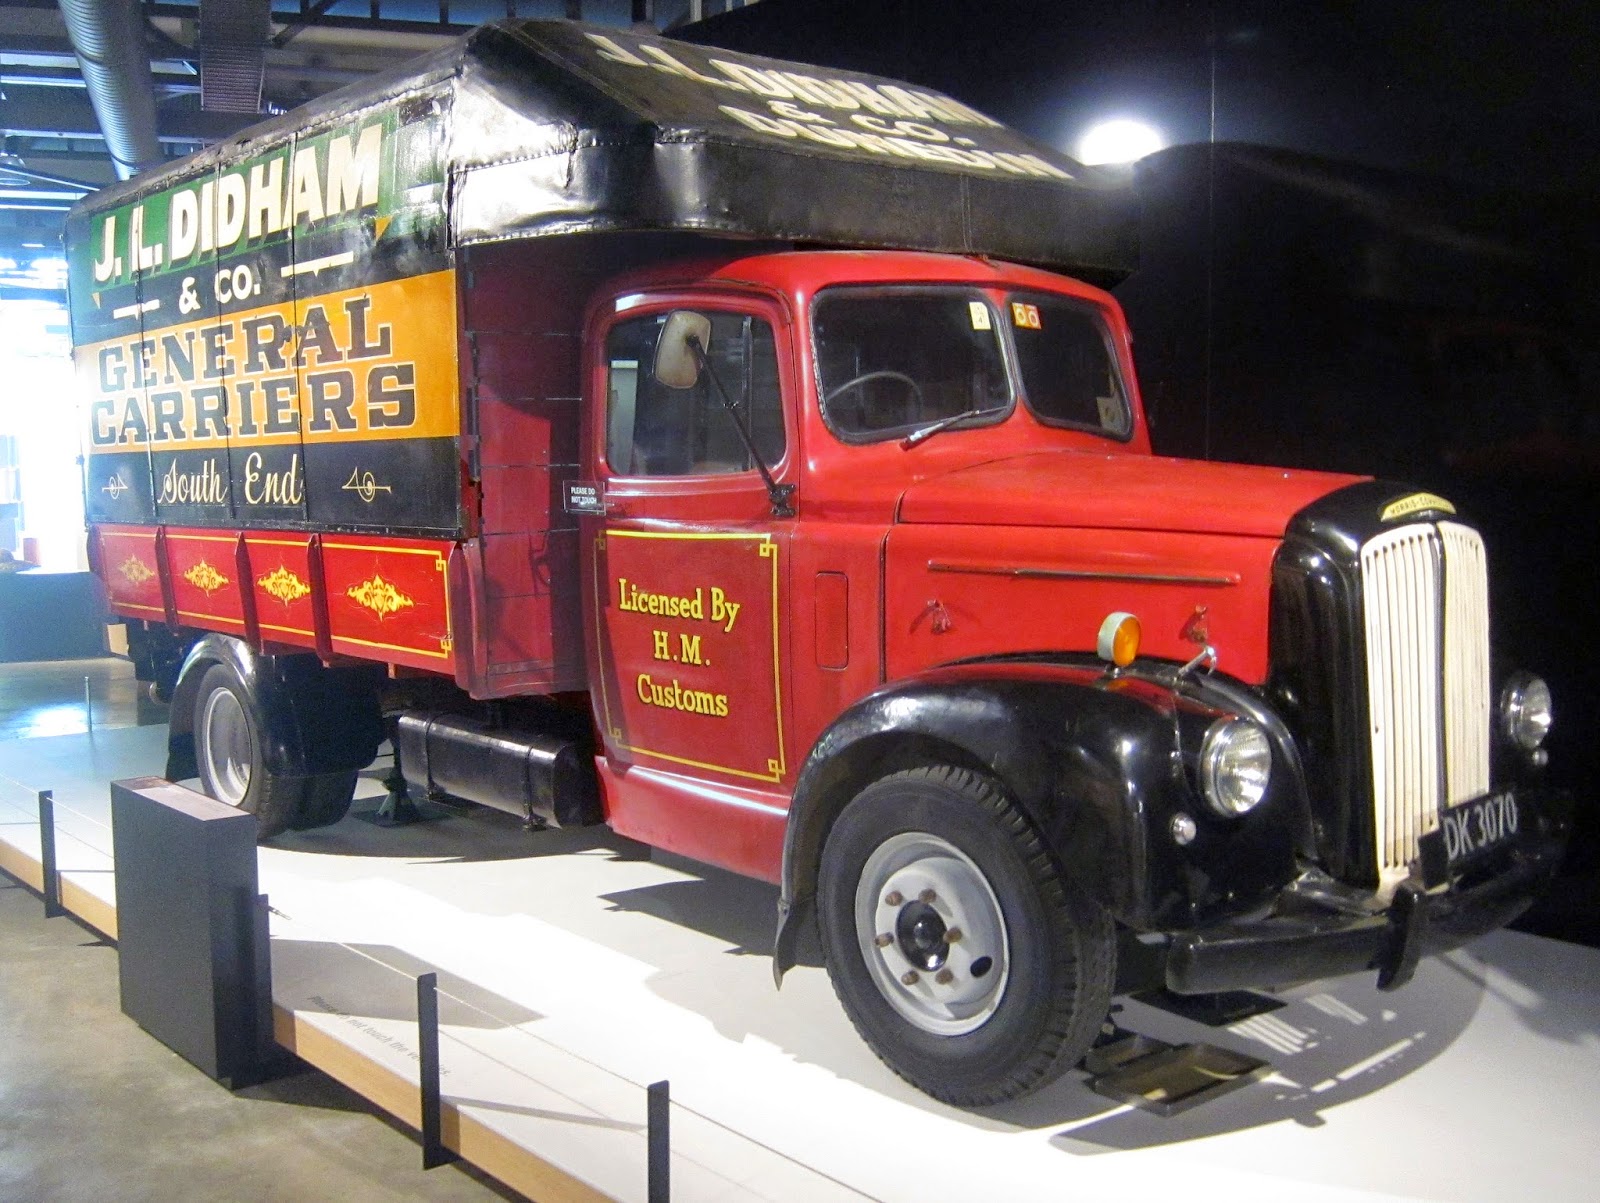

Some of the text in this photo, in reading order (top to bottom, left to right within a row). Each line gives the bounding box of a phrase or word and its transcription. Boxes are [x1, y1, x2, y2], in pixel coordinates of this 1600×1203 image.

[708, 58, 1006, 130] DIDHAM
[766, 100, 978, 147] & CO.
[717, 104, 1076, 181] DUNEDIN
[94, 123, 383, 283] J. L. DIDHAM
[178, 264, 262, 315] & CO.
[98, 294, 393, 394] GENERAL
[91, 362, 417, 448] CARRIERS
[157, 452, 304, 505] South End
[571, 486, 587, 494] PLEASE
[618, 578, 741, 634] Licensed By
[636, 672, 730, 718] Customs
[1442, 791, 1519, 862] DK 3070
